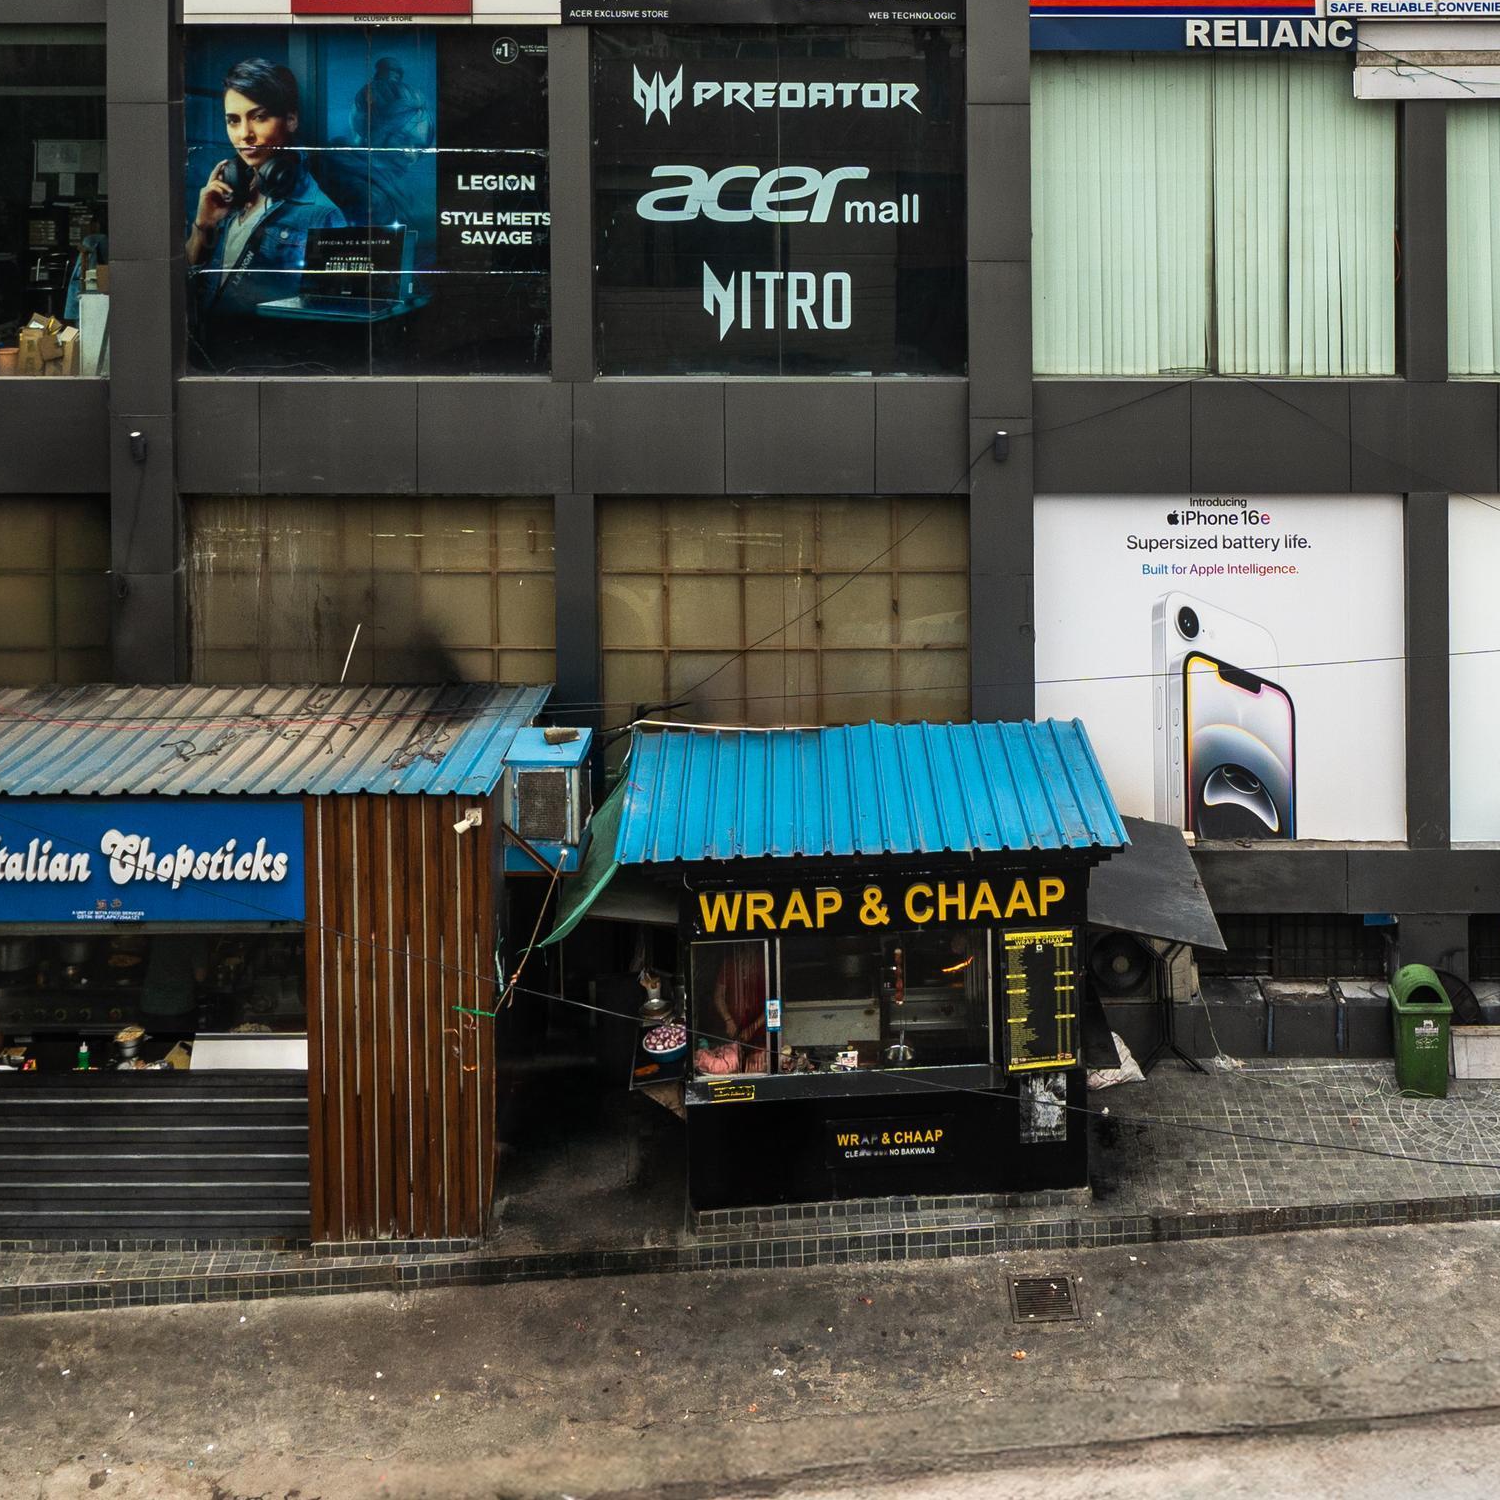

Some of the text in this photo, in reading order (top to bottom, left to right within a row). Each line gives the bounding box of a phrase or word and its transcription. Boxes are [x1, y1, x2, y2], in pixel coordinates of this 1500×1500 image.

[570, 10, 669, 18] ACER EXCLUSIVE STORE
[1330, 2, 1368, 13] SAFE.
[892, 12, 957, 20] TECHNOLOGIC
[495, 42, 509, 57] #1
[692, 81, 924, 115] PREDATOR
[457, 174, 535, 191] LEGION
[636, 165, 919, 224] acer mall
[440, 211, 551, 225] STYLE MEETS
[461, 231, 533, 245] SAVAGE
[703, 260, 852, 342] NITRO
[1189, 497, 1247, 508] Introducing
[1181, 510, 1271, 526] iPhone 16e
[1126, 534, 1312, 552] Supersized battery life.
[1142, 564, 1300, 577] Built for Apple Intelligence.
[101, 828, 289, 890] Chopsticks
[699, 877, 1065, 932] WRAP & CHAAP
[837, 1130, 943, 1146] WRAP & CHAAP
[901, 1147, 935, 1156] BAKWAAS
